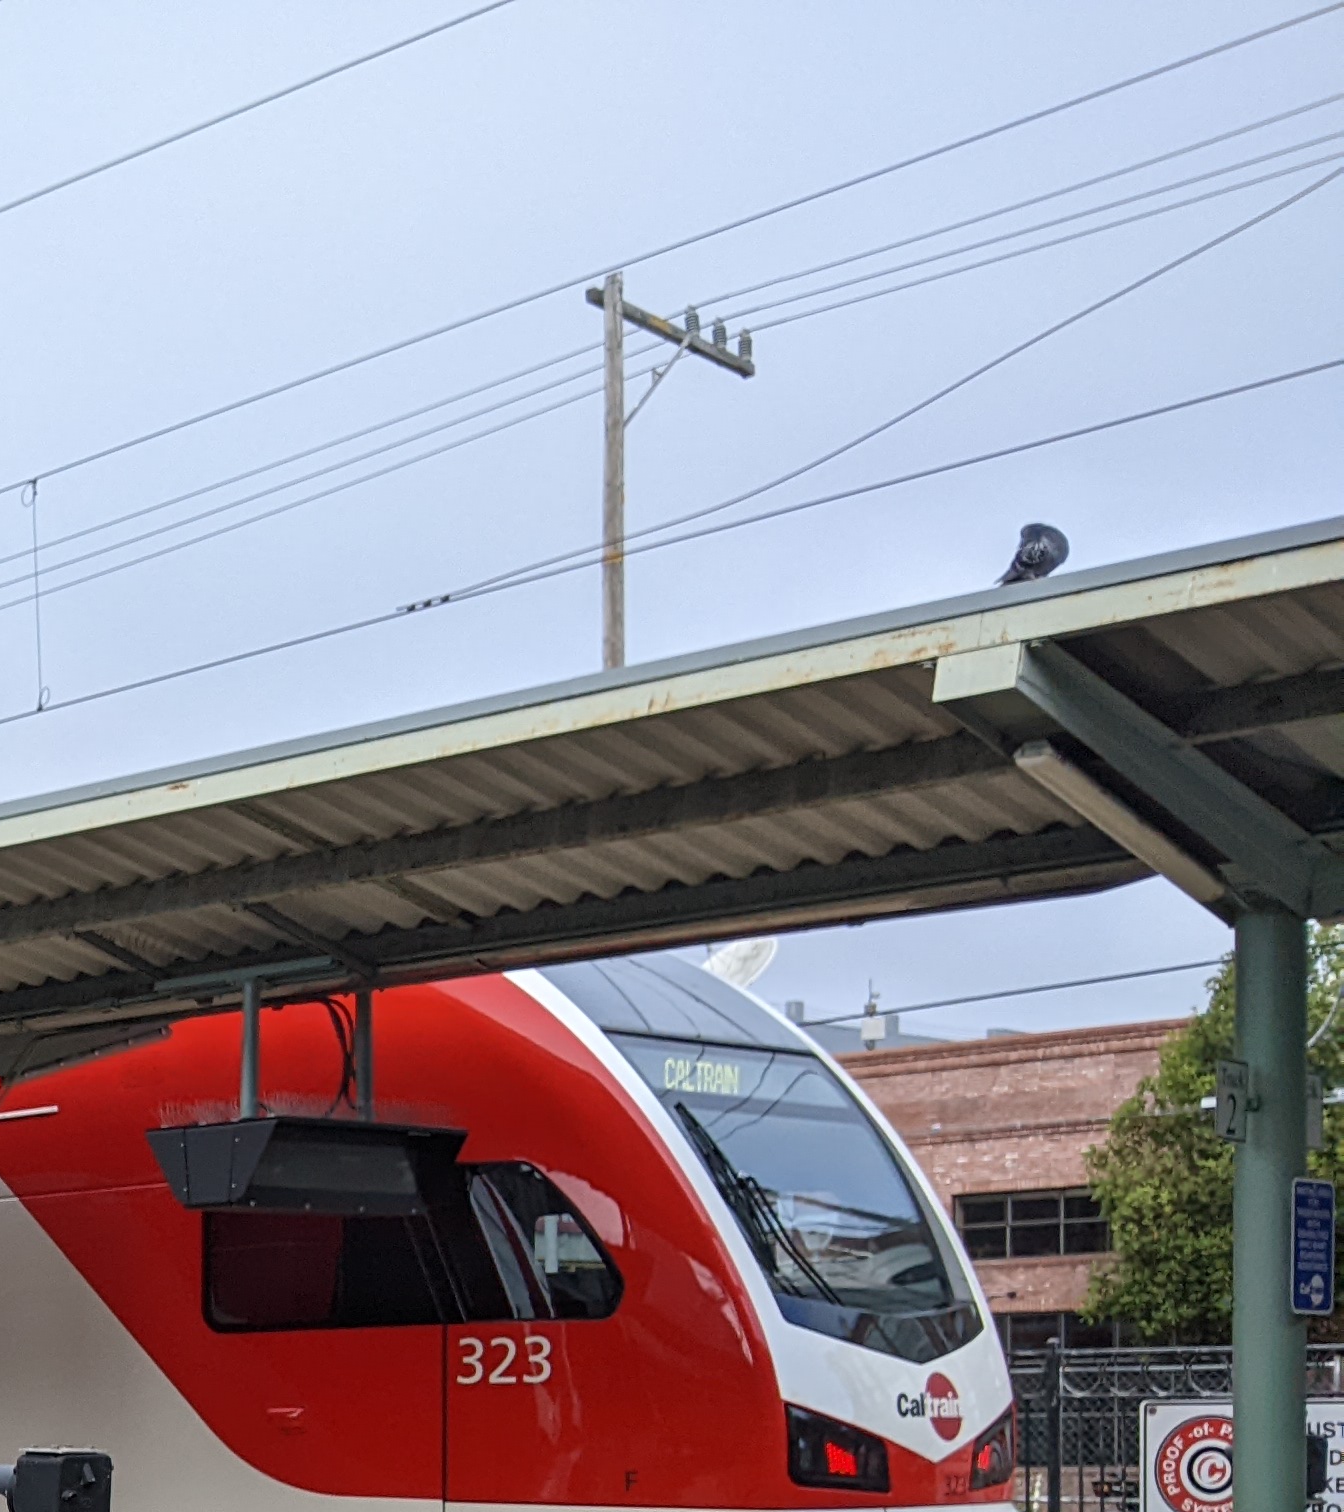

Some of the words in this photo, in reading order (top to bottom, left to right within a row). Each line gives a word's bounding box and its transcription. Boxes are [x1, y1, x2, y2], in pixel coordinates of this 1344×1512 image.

[664, 1057, 741, 1095] CALTRAIN
[1226, 1093, 1236, 1135] 2
[456, 1335, 553, 1384] 323
[897, 1391, 961, 1418] Caltrain
[1163, 1435, 1185, 1497] PROOF
[1219, 1423, 1233, 1441] P
[625, 1470, 638, 1491] F
